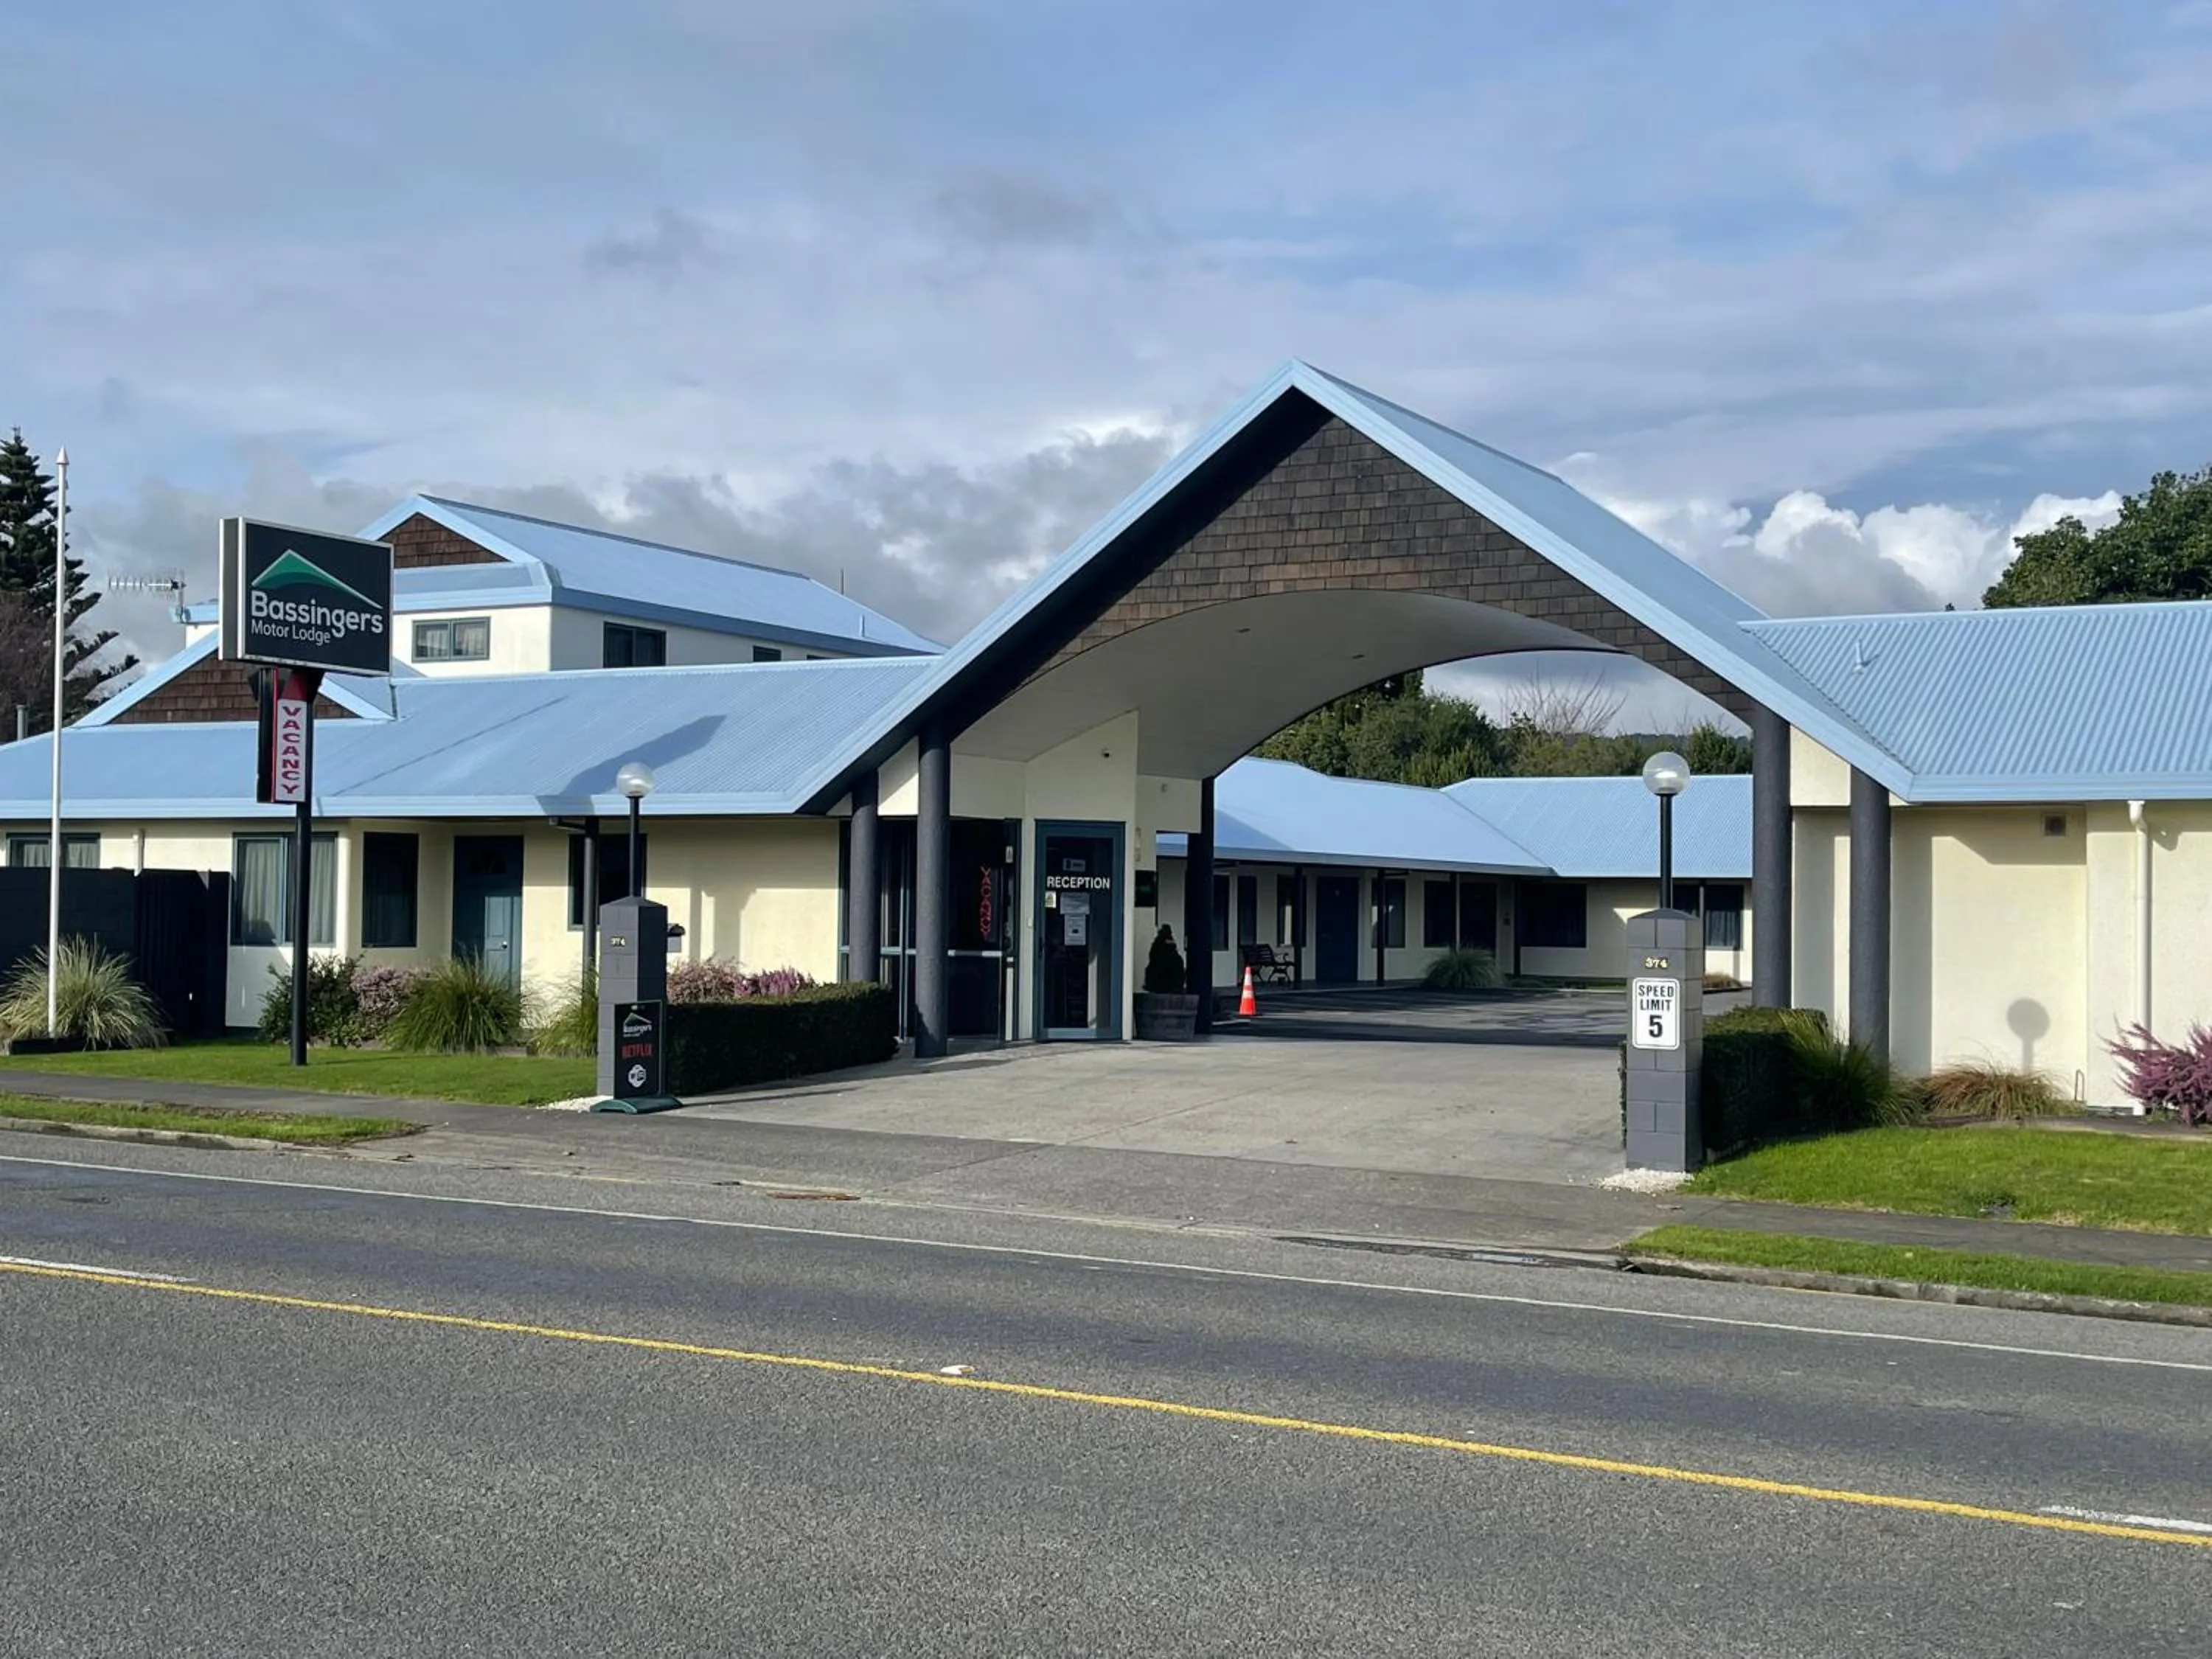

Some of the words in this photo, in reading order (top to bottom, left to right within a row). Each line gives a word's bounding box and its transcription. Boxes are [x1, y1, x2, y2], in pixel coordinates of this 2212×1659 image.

[251, 591, 383, 638] Bassingers
[251, 619, 290, 637] Motor
[293, 625, 331, 646] Lodge
[283, 706, 301, 794] VACANCY
[1047, 875, 1110, 889] RECEPTION
[980, 866, 992, 941] VACANCY
[1645, 957, 1668, 968] 374
[1638, 984, 1674, 998] SPEED
[1640, 999, 1672, 1012] LIMIT
[1649, 1015, 1663, 1038] 5
